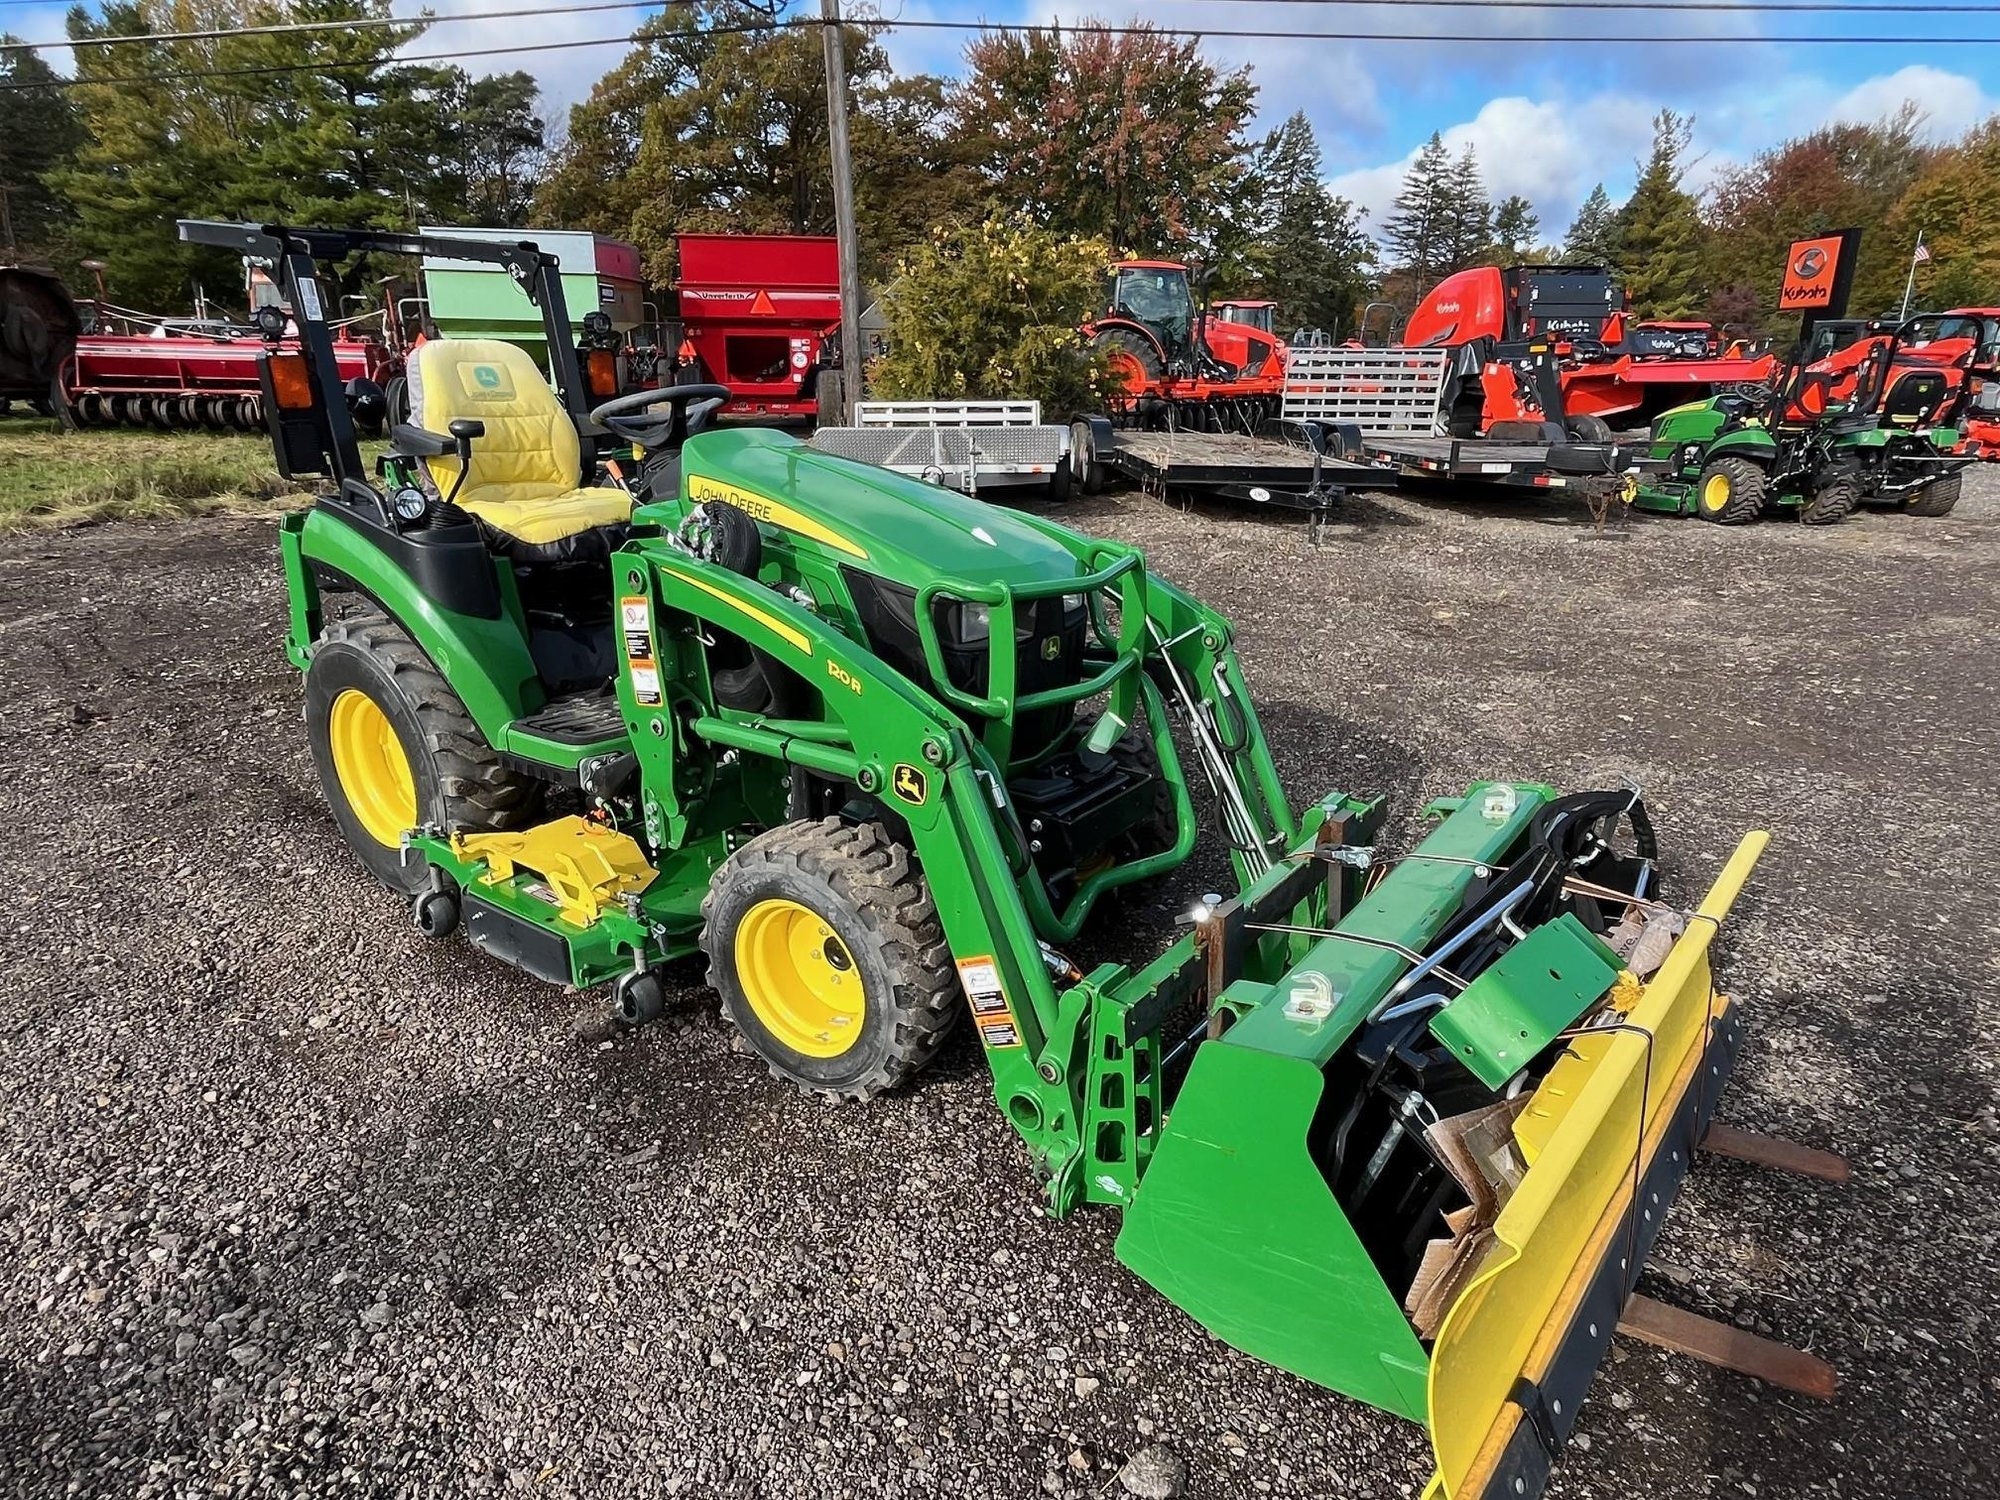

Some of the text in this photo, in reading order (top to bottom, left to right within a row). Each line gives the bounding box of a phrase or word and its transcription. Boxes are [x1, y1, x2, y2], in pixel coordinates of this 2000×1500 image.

[702, 292, 745, 300] Unverferth
[1784, 284, 1827, 301] Kubota
[1436, 302, 1460, 314] Kubota
[1547, 319, 1590, 333] Kubota
[1651, 339, 1676, 349] Kubota
[695, 484, 772, 520] JOHN DEERE
[826, 658, 862, 696] 120R
